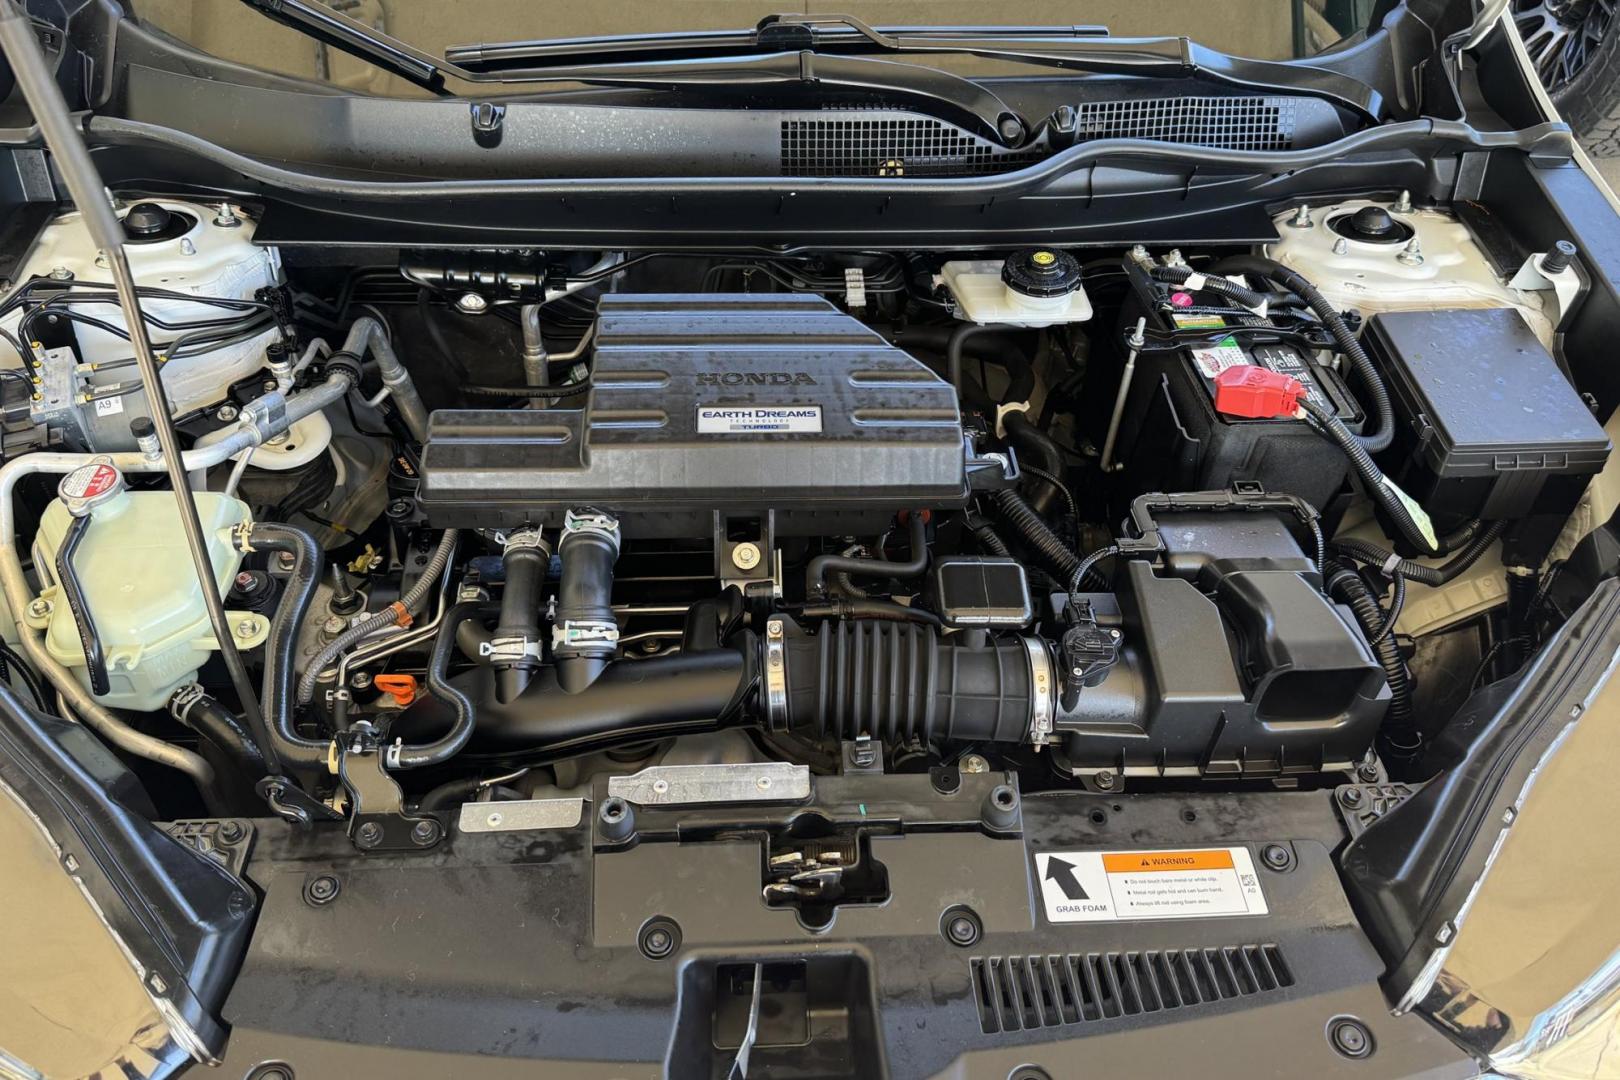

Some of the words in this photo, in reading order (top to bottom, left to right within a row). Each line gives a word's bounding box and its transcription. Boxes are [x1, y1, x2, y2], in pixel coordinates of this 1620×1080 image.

[696, 372, 818, 386] HONDA
[98, 399, 112, 409] A9
[755, 410, 816, 418] DREAMS
[1151, 857, 1195, 866] WARNING
[1056, 905, 1081, 913] GRAB
[1083, 904, 1107, 912] FOAM
